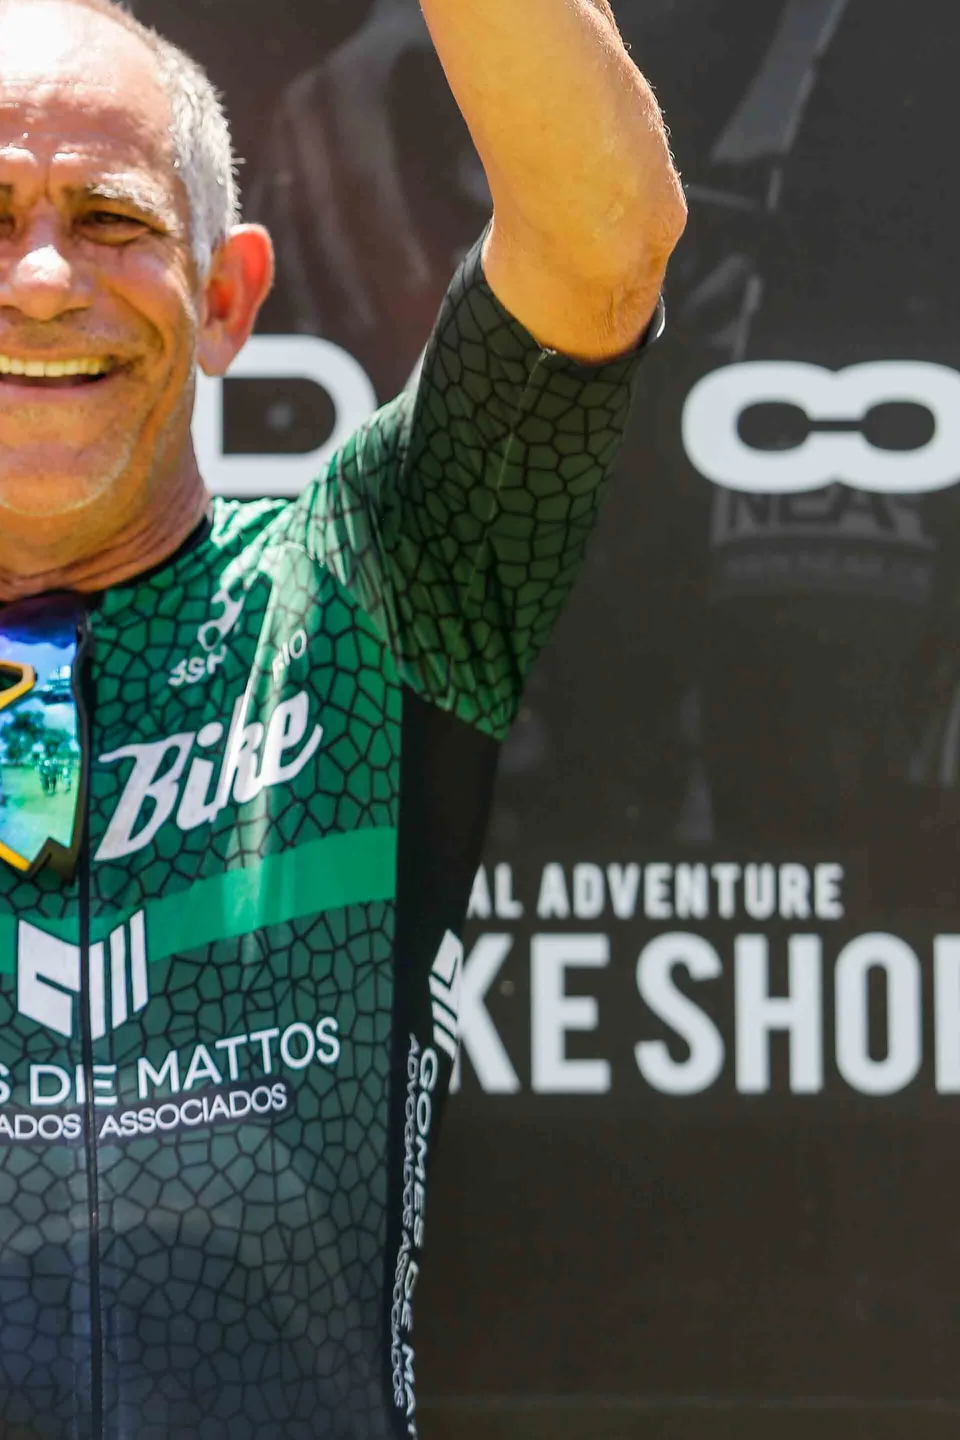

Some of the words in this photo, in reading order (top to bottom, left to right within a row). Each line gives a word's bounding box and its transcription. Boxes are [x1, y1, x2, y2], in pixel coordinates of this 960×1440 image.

[94, 689, 324, 862] Bike
[537, 862, 845, 919] ADVENTURE
[29, 1063, 118, 1107] DE
[138, 1016, 341, 1101] MATTOS
[99, 1082, 288, 1140] ASSOCIADOS
[413, 1047, 439, 1248] GOMES
